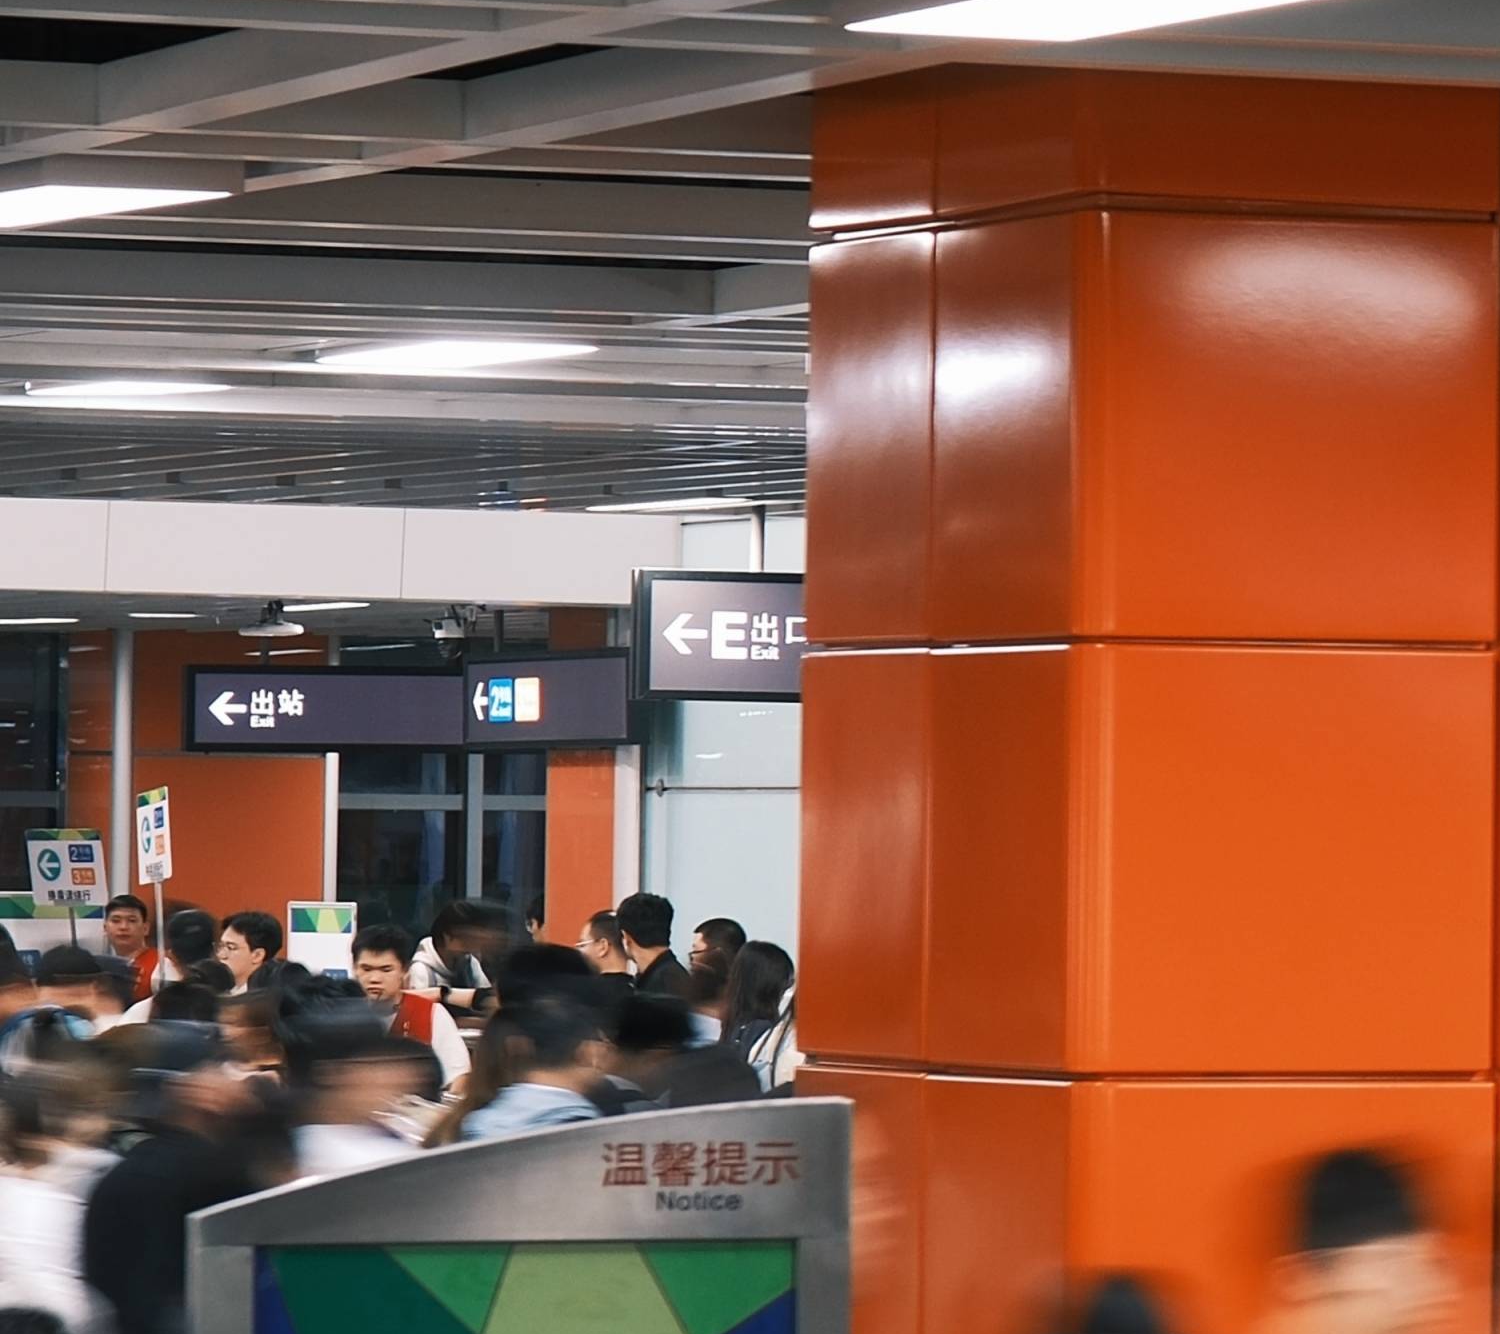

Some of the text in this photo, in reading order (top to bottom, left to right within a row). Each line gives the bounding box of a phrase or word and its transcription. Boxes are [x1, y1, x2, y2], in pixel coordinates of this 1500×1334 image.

[250, 688, 304, 717] 出站
[602, 1141, 800, 1187] 温馨提示
[655, 1191, 743, 1210] Notice
